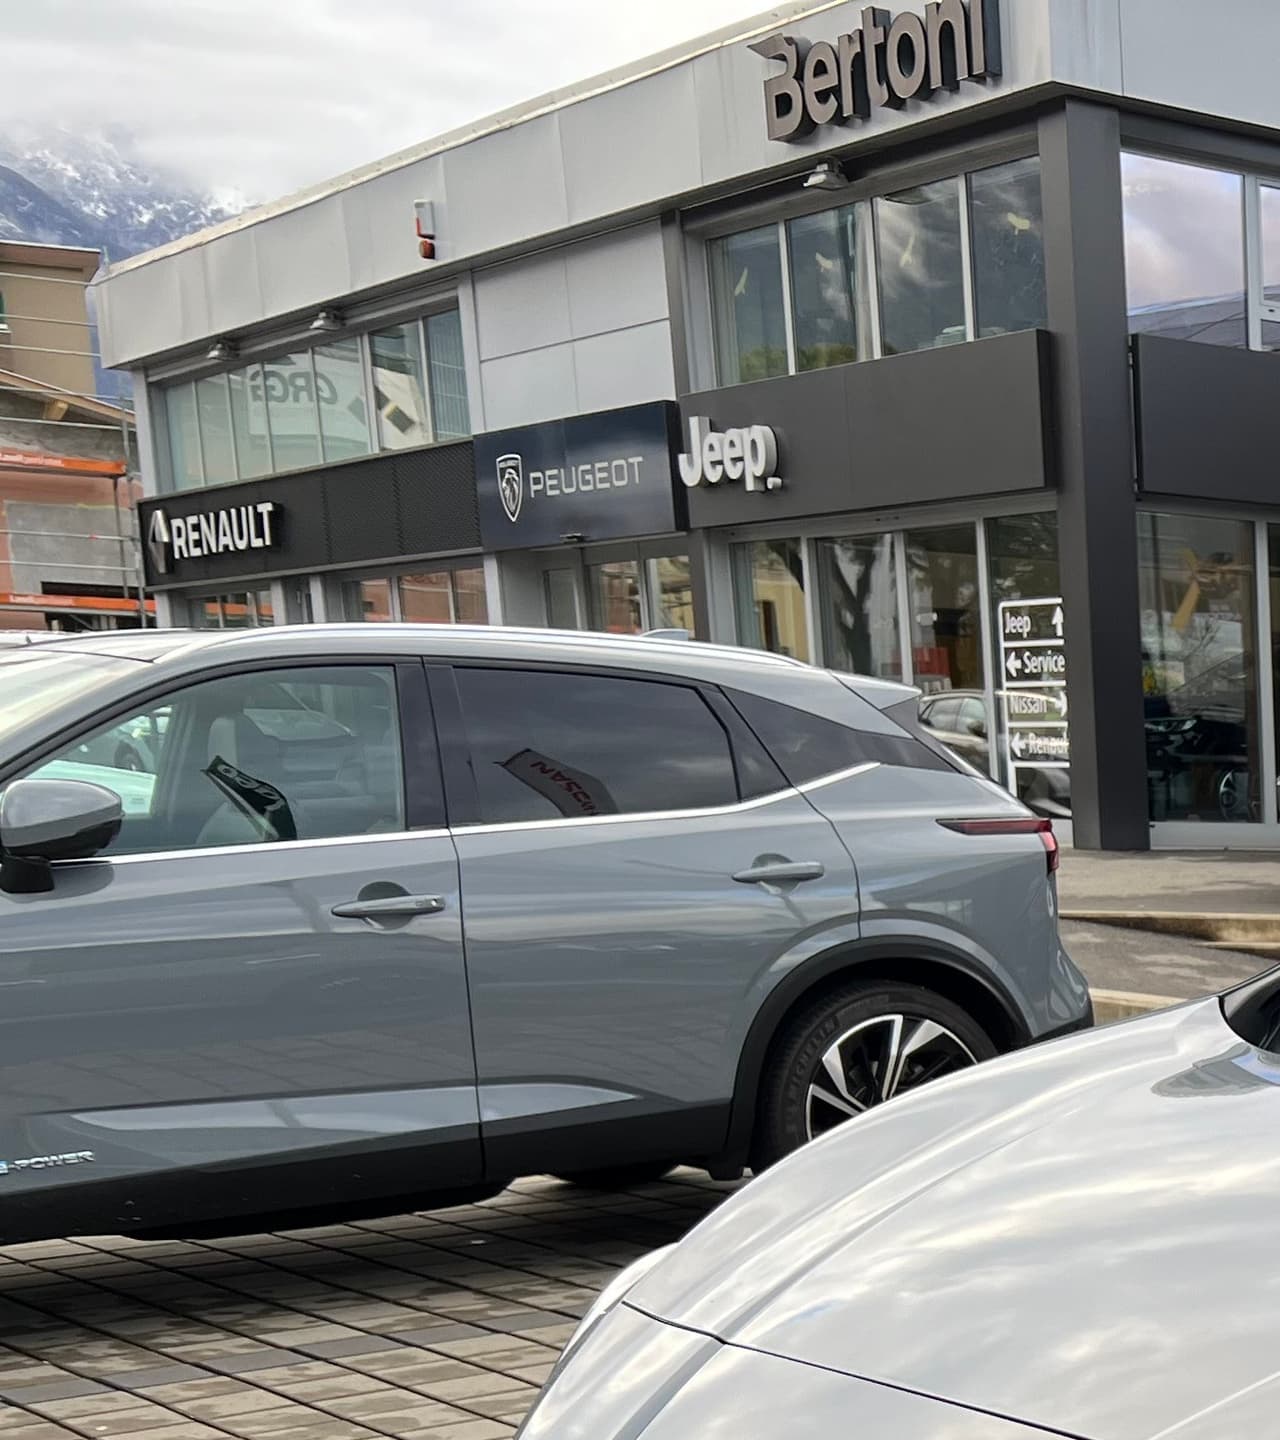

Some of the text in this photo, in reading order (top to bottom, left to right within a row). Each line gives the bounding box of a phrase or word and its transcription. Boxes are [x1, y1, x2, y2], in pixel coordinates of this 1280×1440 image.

[747, 0, 995, 142] Bertoni
[678, 416, 778, 492] Jeep
[529, 456, 644, 498] PEUGEOT
[170, 502, 274, 560] RENAULT
[1005, 612, 1032, 638] Jeep
[1024, 651, 1066, 674] Service
[1010, 693, 1048, 714] Nissan
